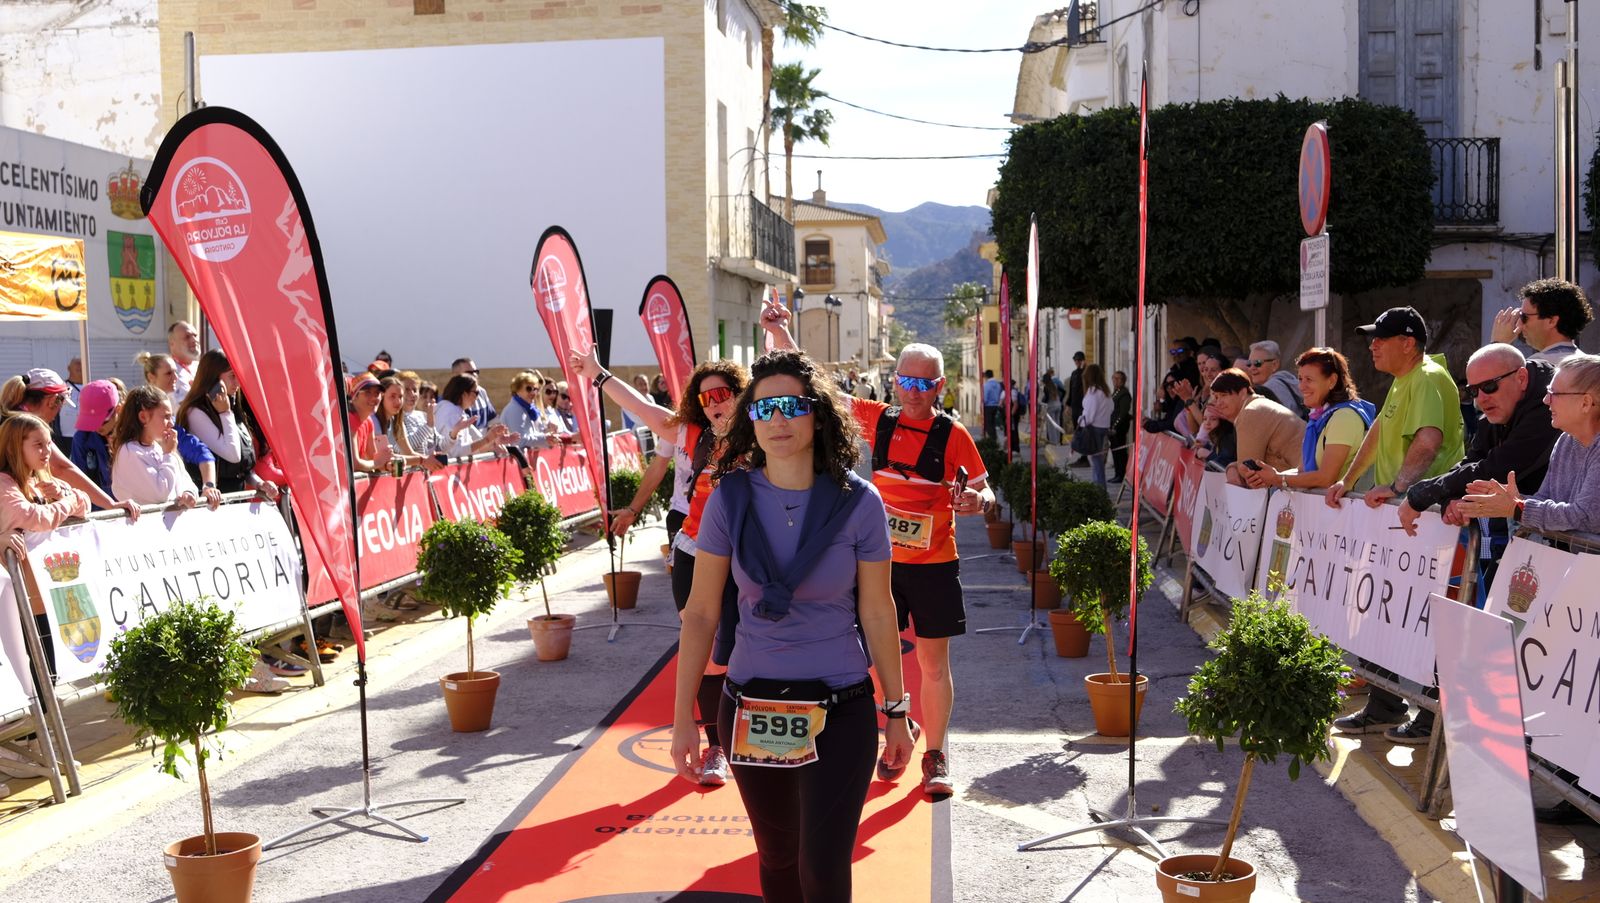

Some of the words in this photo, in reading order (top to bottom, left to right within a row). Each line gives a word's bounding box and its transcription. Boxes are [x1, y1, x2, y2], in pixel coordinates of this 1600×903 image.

[0, 162, 98, 202] CELENTÍSIMO
[0, 201, 97, 237] UNTAMIENTO
[552, 466, 592, 497] VEOLIA
[888, 517, 921, 535] 487
[105, 536, 251, 577] AYUNTAMIENTO
[255, 532, 278, 549] DE
[1417, 555, 1438, 580] DE
[110, 555, 290, 626] CANTORIA
[751, 714, 808, 738] 598
